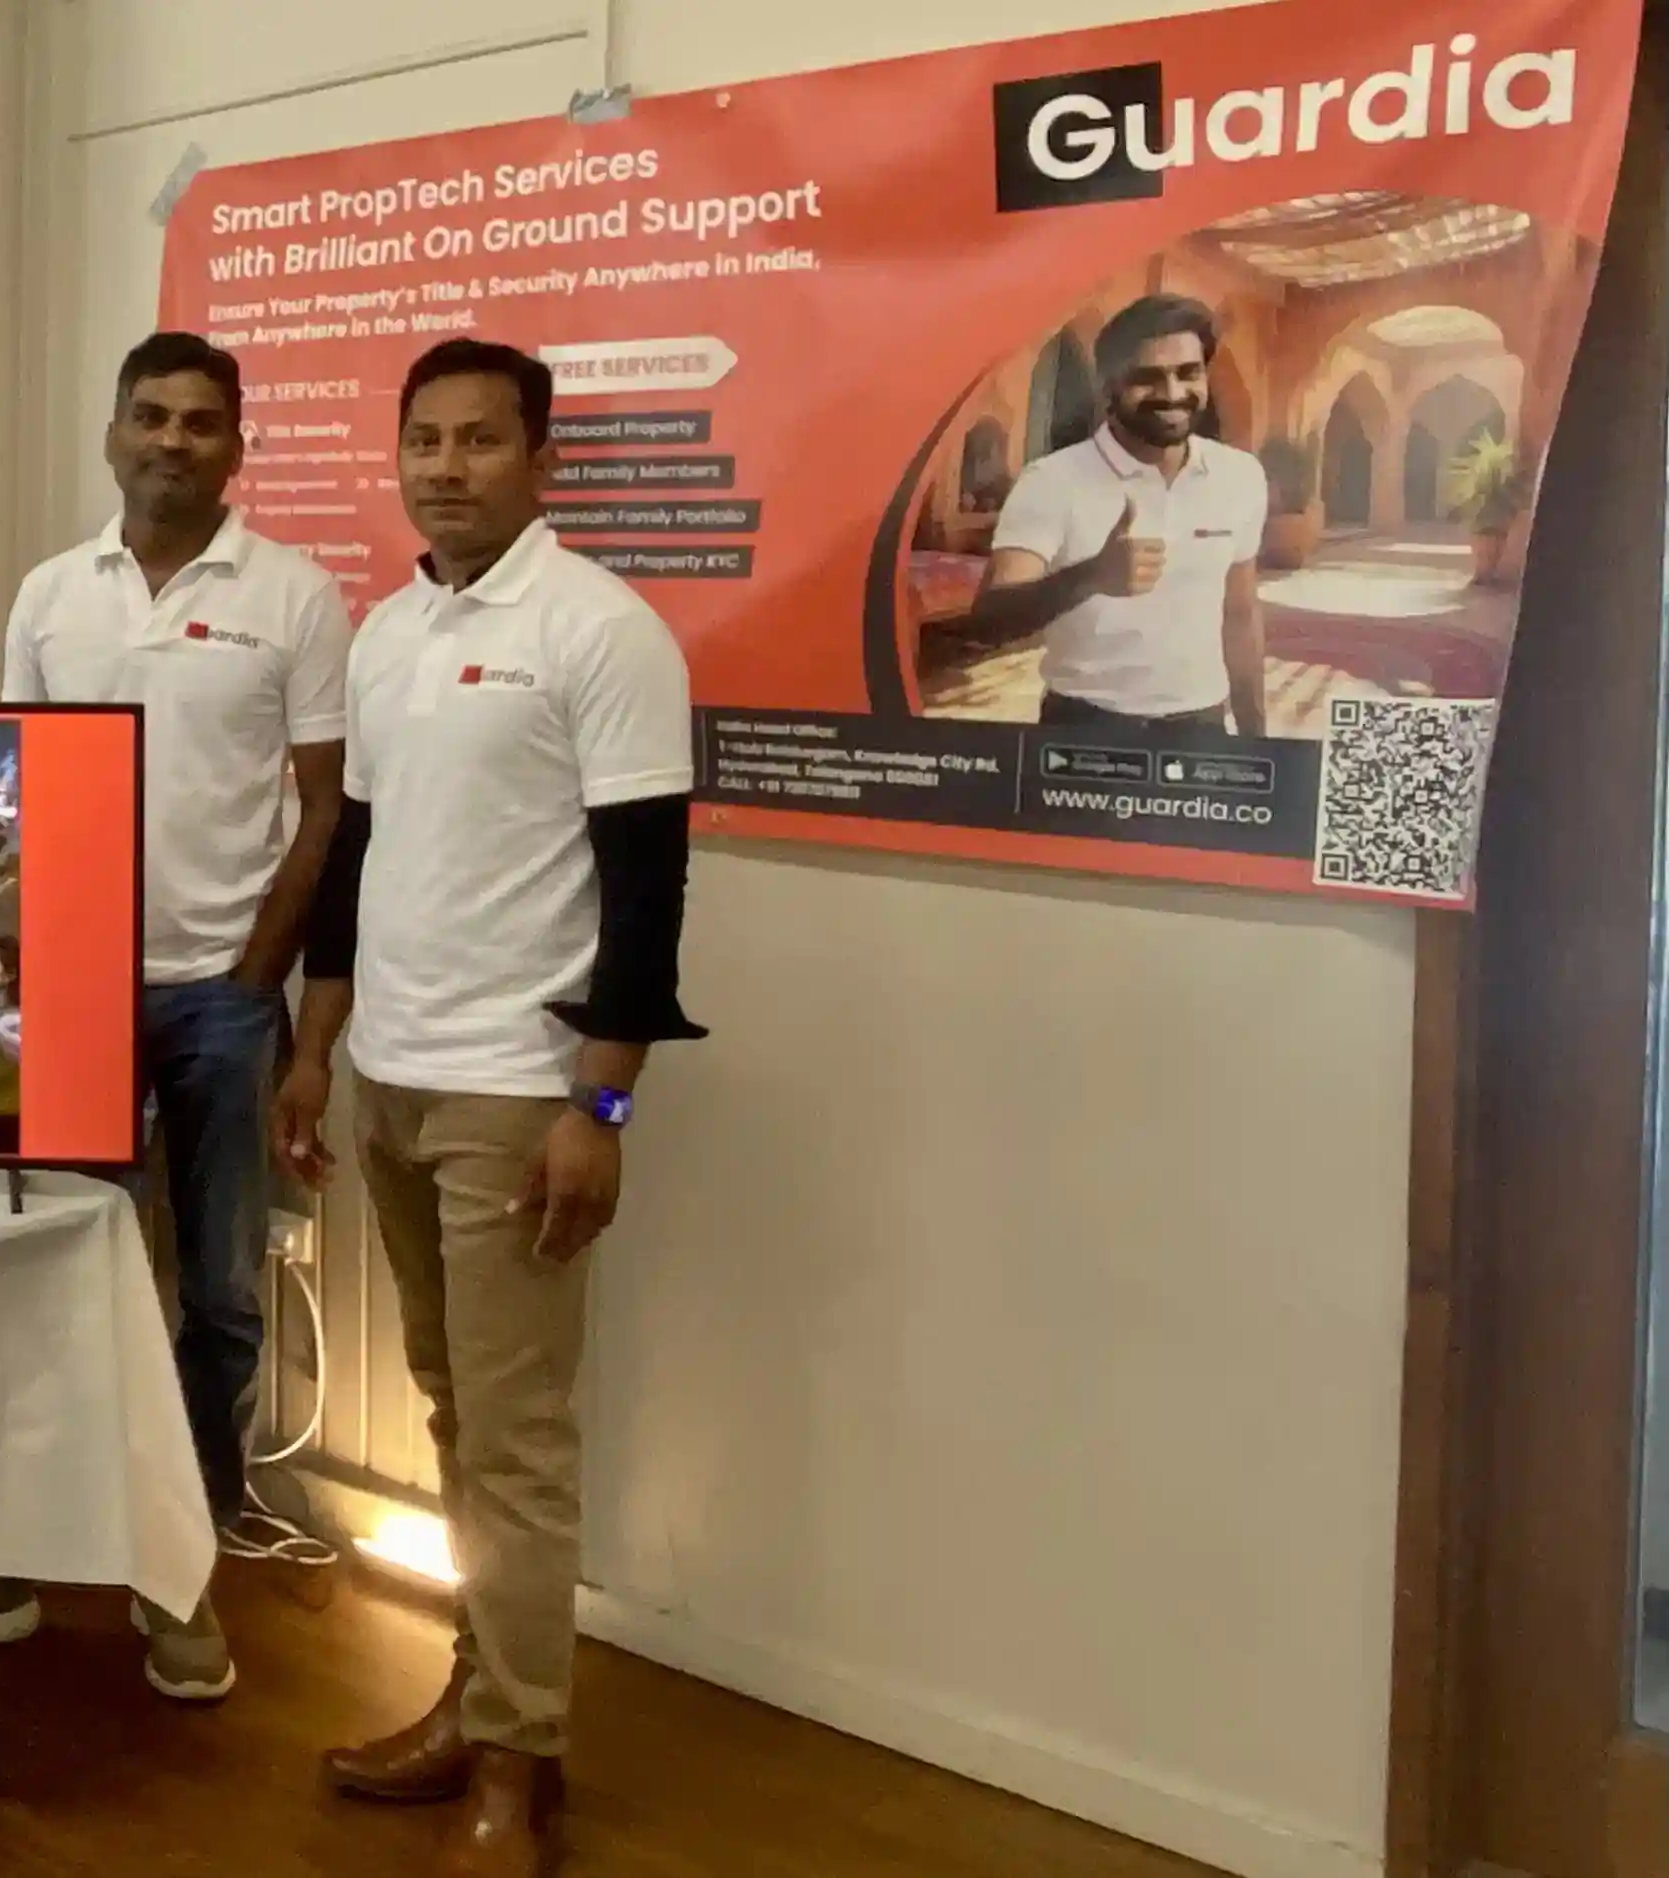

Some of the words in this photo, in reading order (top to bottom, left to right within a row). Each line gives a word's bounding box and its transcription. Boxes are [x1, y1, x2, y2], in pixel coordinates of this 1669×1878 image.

[1027, 33, 1576, 180] Guardia
[212, 194, 311, 235] Smart
[320, 169, 484, 225] PropTech
[494, 148, 659, 198] Services
[208, 245, 275, 282] with
[285, 231, 416, 275] Brilliant
[423, 225, 473, 259] On
[483, 200, 628, 252] Ground
[641, 180, 822, 240] Support
[268, 296, 311, 316] Your
[315, 287, 416, 314] Property's
[421, 282, 464, 302] Title
[468, 278, 483, 299] &
[488, 268, 578, 297] Security
[583, 258, 710, 291] Anywhere
[715, 252, 739, 276] in
[745, 246, 821, 274] India,
[251, 322, 347, 348] Anywhere
[352, 316, 371, 337] in
[374, 315, 406, 334] the
[411, 308, 478, 333] World.
[602, 352, 710, 378] SERVICES
[274, 378, 360, 400] SERVICES
[940, 753, 973, 774] City
[1042, 789, 1272, 824] www.guardia.co
